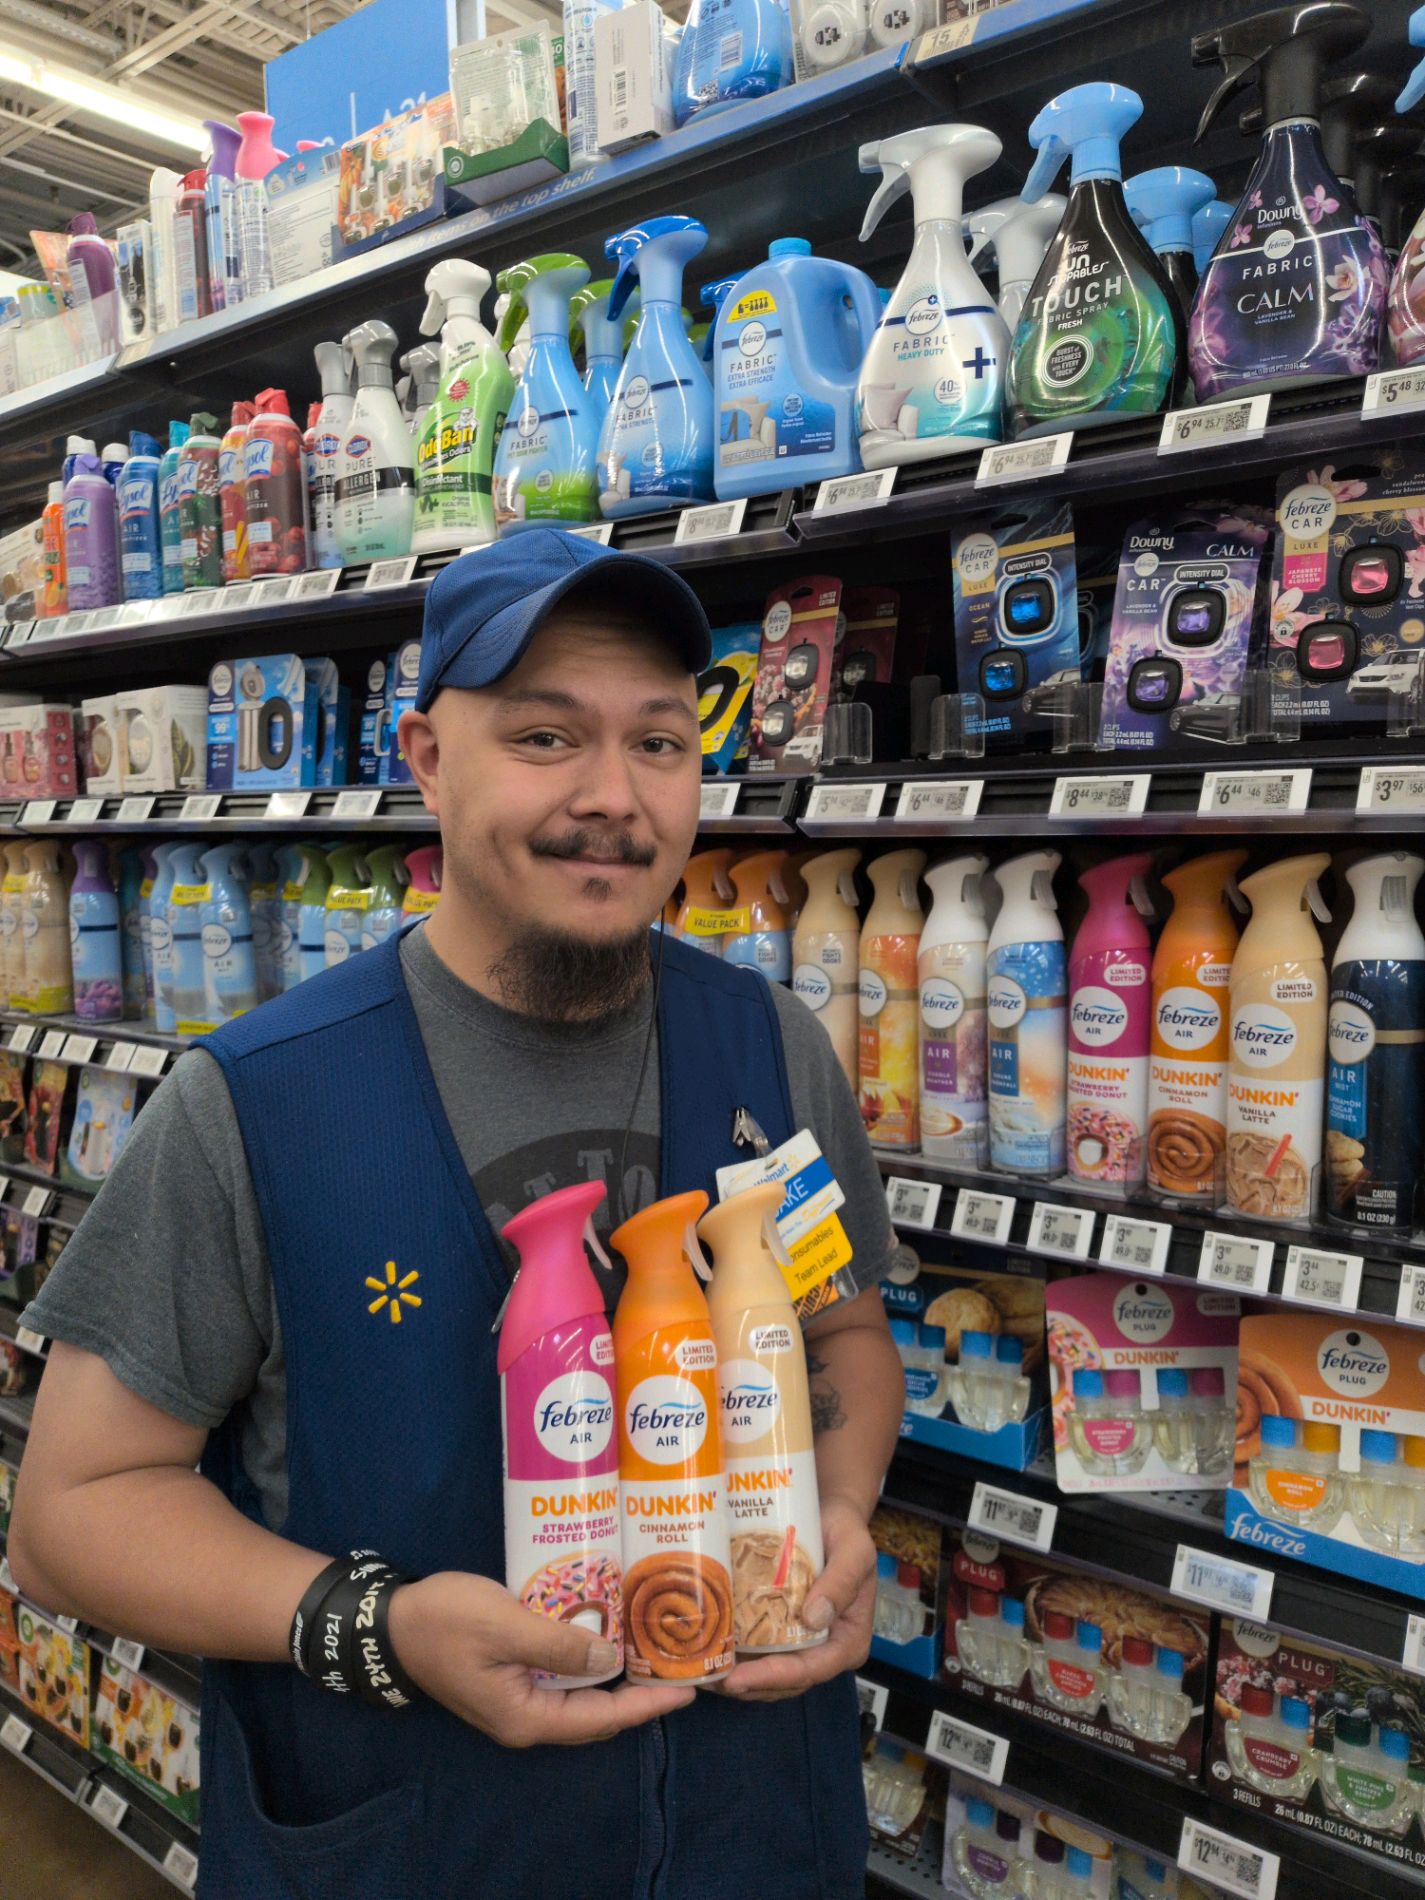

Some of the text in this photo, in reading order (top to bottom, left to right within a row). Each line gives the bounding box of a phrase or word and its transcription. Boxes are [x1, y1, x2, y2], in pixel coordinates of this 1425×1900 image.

[494, 201, 516, 219] the
[521, 190, 548, 208] top
[552, 167, 596, 195] shelf.
[1258, 205, 1304, 222] Downy
[1242, 256, 1313, 280] FABRIC
[1031, 275, 1123, 317] TOUCH
[1237, 283, 1314, 314] CALM
[1076, 302, 1108, 316] SPRAY
[908, 310, 939, 325] febreze
[1057, 320, 1083, 331] FRESH
[924, 348, 944, 357] DUTY
[1052, 352, 1082, 364] FRESHNESS
[730, 355, 774, 372] FABRIC
[1062, 360, 1079, 368] EVERY
[728, 366, 776, 382] EXTRA STRENGTH
[1056, 368, 1073, 378] TOUCH
[729, 380, 746, 390] EXTRA
[939, 380, 954, 393] 40
[510, 437, 545, 450] FABRIC
[1285, 501, 1332, 520] febreze
[1292, 518, 1323, 529] CAR
[1130, 536, 1174, 550] Downy
[1206, 543, 1254, 557] CALM
[1293, 542, 1319, 550] LUXE
[960, 547, 994, 565] febreze
[965, 561, 990, 574] CAR
[1127, 579, 1159, 591] CAR
[969, 603, 990, 612] OCEAN
[694, 918, 739, 928] VALUE PACK
[1278, 983, 1311, 991] LIMITED
[922, 992, 959, 1010] febreze
[1072, 1004, 1124, 1024] febreze
[1159, 1005, 1218, 1026] febreze
[1176, 1030, 1193, 1038] AIR
[1234, 1022, 1294, 1045] febreze
[928, 1048, 950, 1058] AIR
[993, 1048, 1012, 1060] AIR
[1249, 1048, 1267, 1056] AIR
[1332, 1067, 1356, 1083] AIR
[1239, 1106, 1276, 1118] VANILLA
[1242, 1115, 1269, 1124] LATTE
[795, 1249, 837, 1284] Team Lead
[1118, 1304, 1170, 1321] febreze
[1114, 1351, 1179, 1365] DUNKIN'
[1321, 1348, 1387, 1374] febreze
[1339, 1374, 1366, 1385] PLUG
[540, 1400, 611, 1432] febreze
[630, 1403, 705, 1434] febreze
[1312, 1401, 1390, 1425] DUNKIN'
[731, 1416, 752, 1426] AIR
[570, 1432, 592, 1444] AIR
[656, 1436, 679, 1446] AIR
[626, 1491, 716, 1517] DUNKIN'
[728, 1497, 773, 1508] VANILLA
[735, 1508, 768, 1518] LATTE
[543, 1516, 613, 1533] STRAWBERRY
[639, 1521, 704, 1534] CINNAMON
[532, 1533, 586, 1544] FROSTED
[657, 1533, 688, 1544] ROLL
[1230, 1513, 1306, 1555] febreze
[960, 1561, 998, 1581] PLUG
[325, 1613, 342, 1661] 2021
[1278, 1652, 1326, 1677] PLUG
